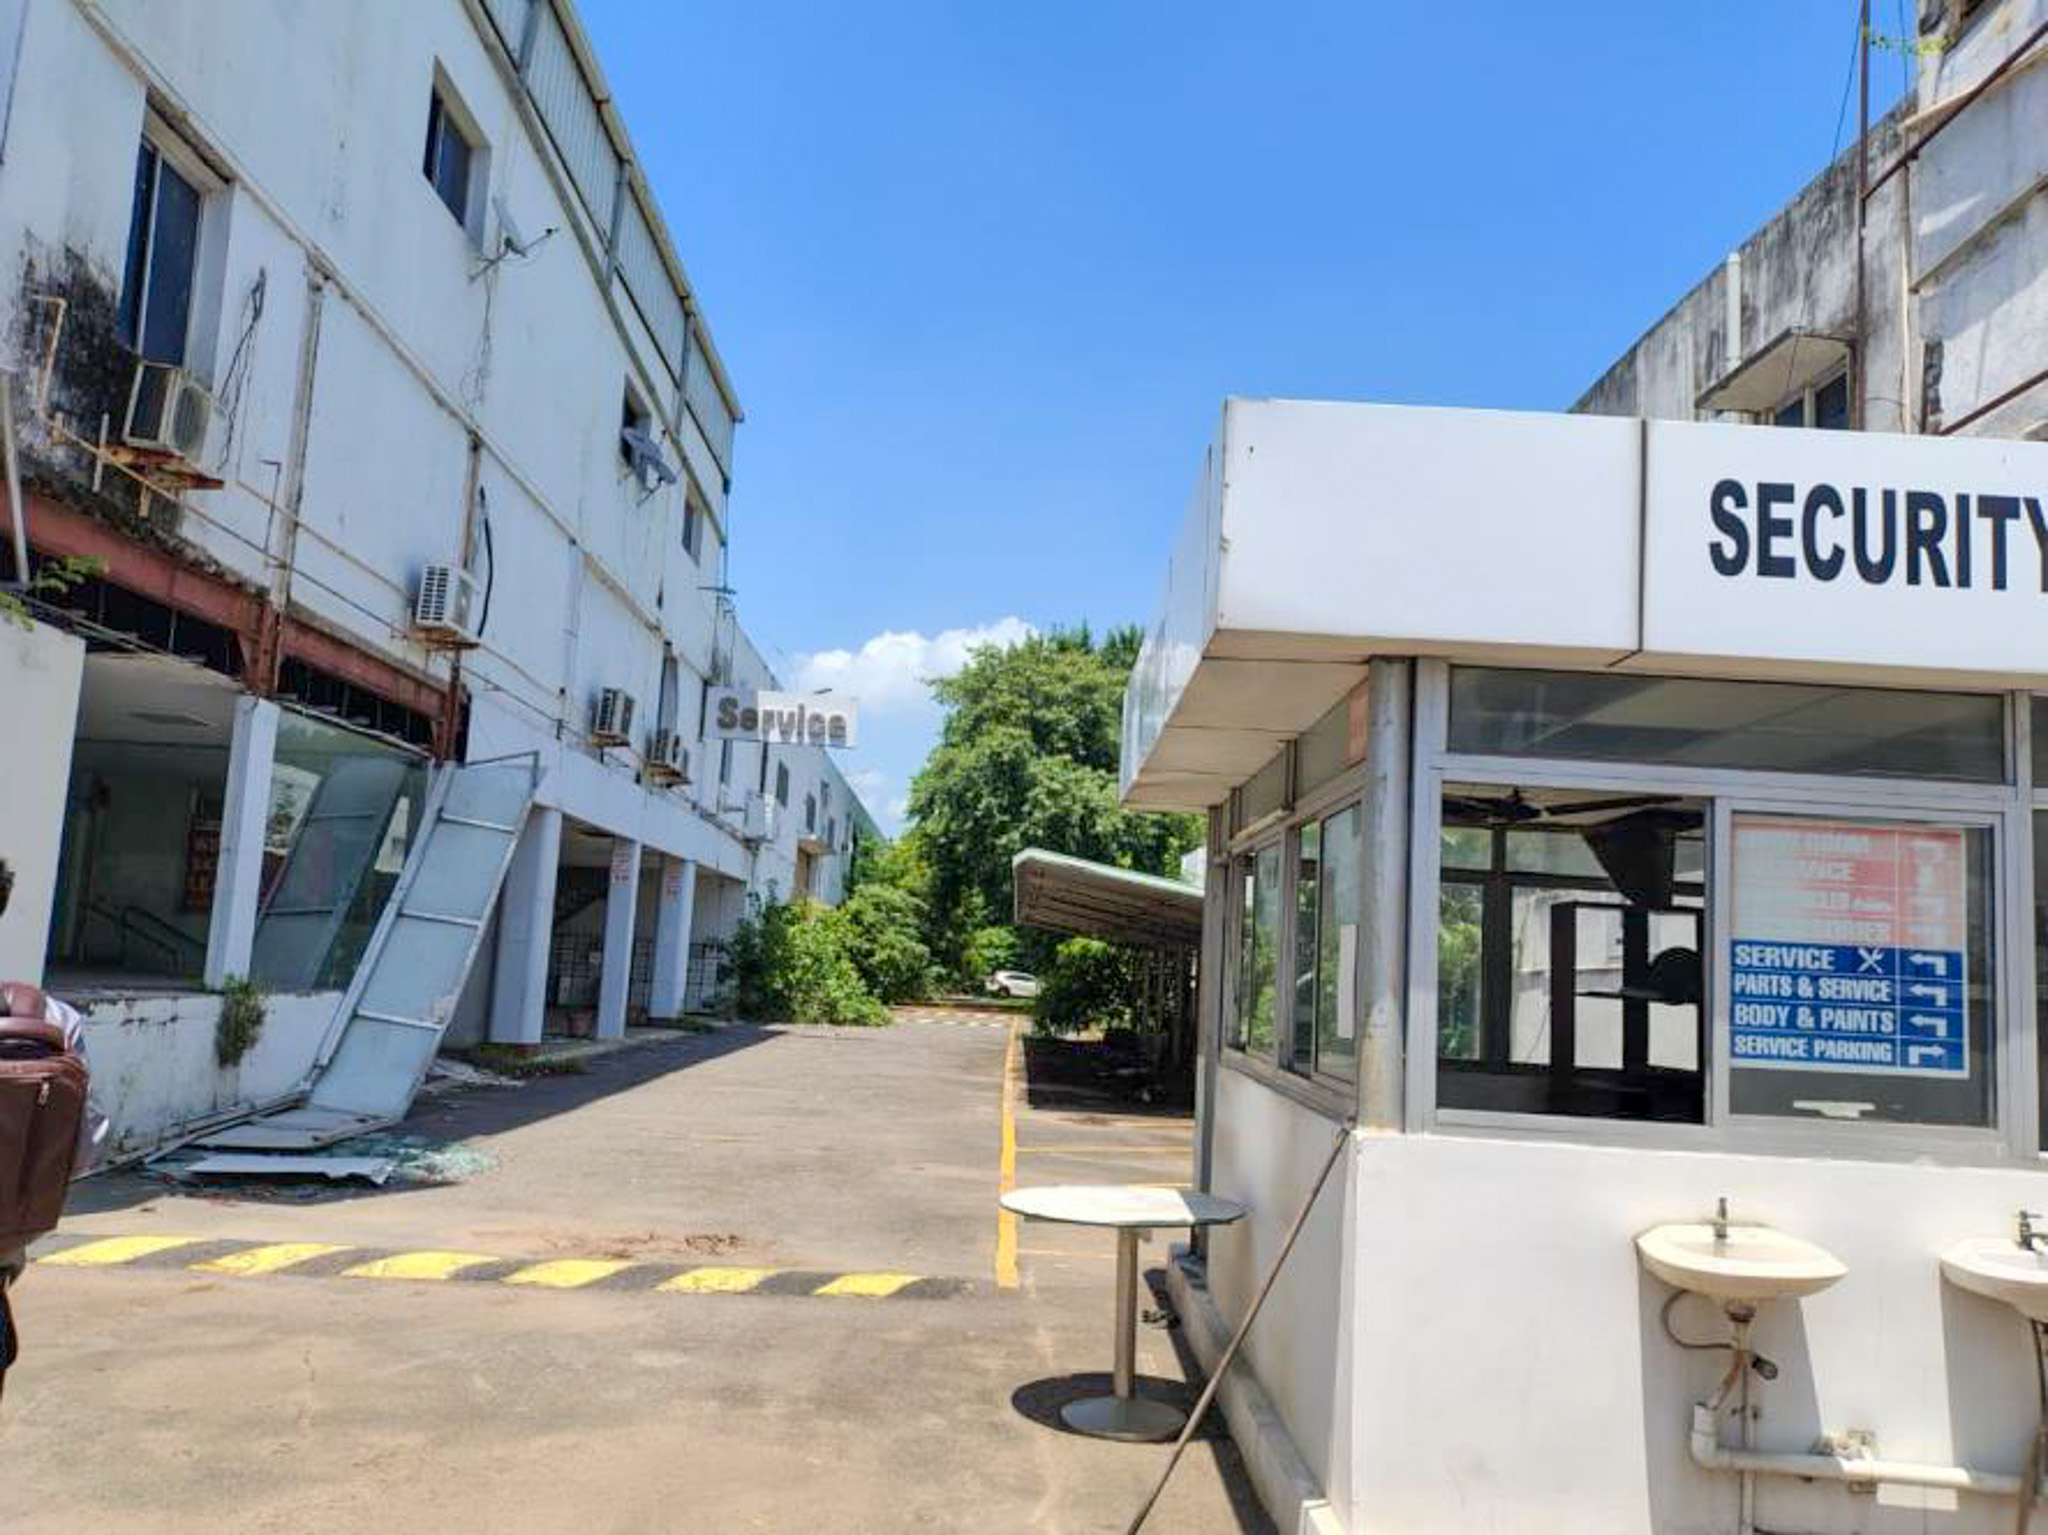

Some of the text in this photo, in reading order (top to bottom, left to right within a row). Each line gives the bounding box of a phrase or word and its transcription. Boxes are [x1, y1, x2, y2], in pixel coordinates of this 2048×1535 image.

[717, 696, 847, 746] Service
[1735, 946, 1835, 971] SERVICE
[1735, 973, 1892, 1002] PARTS & SERVICE
[1735, 1004, 1895, 1033] BODY & PAINTS
[1735, 1035, 1893, 1063] SERVICE PARKING
